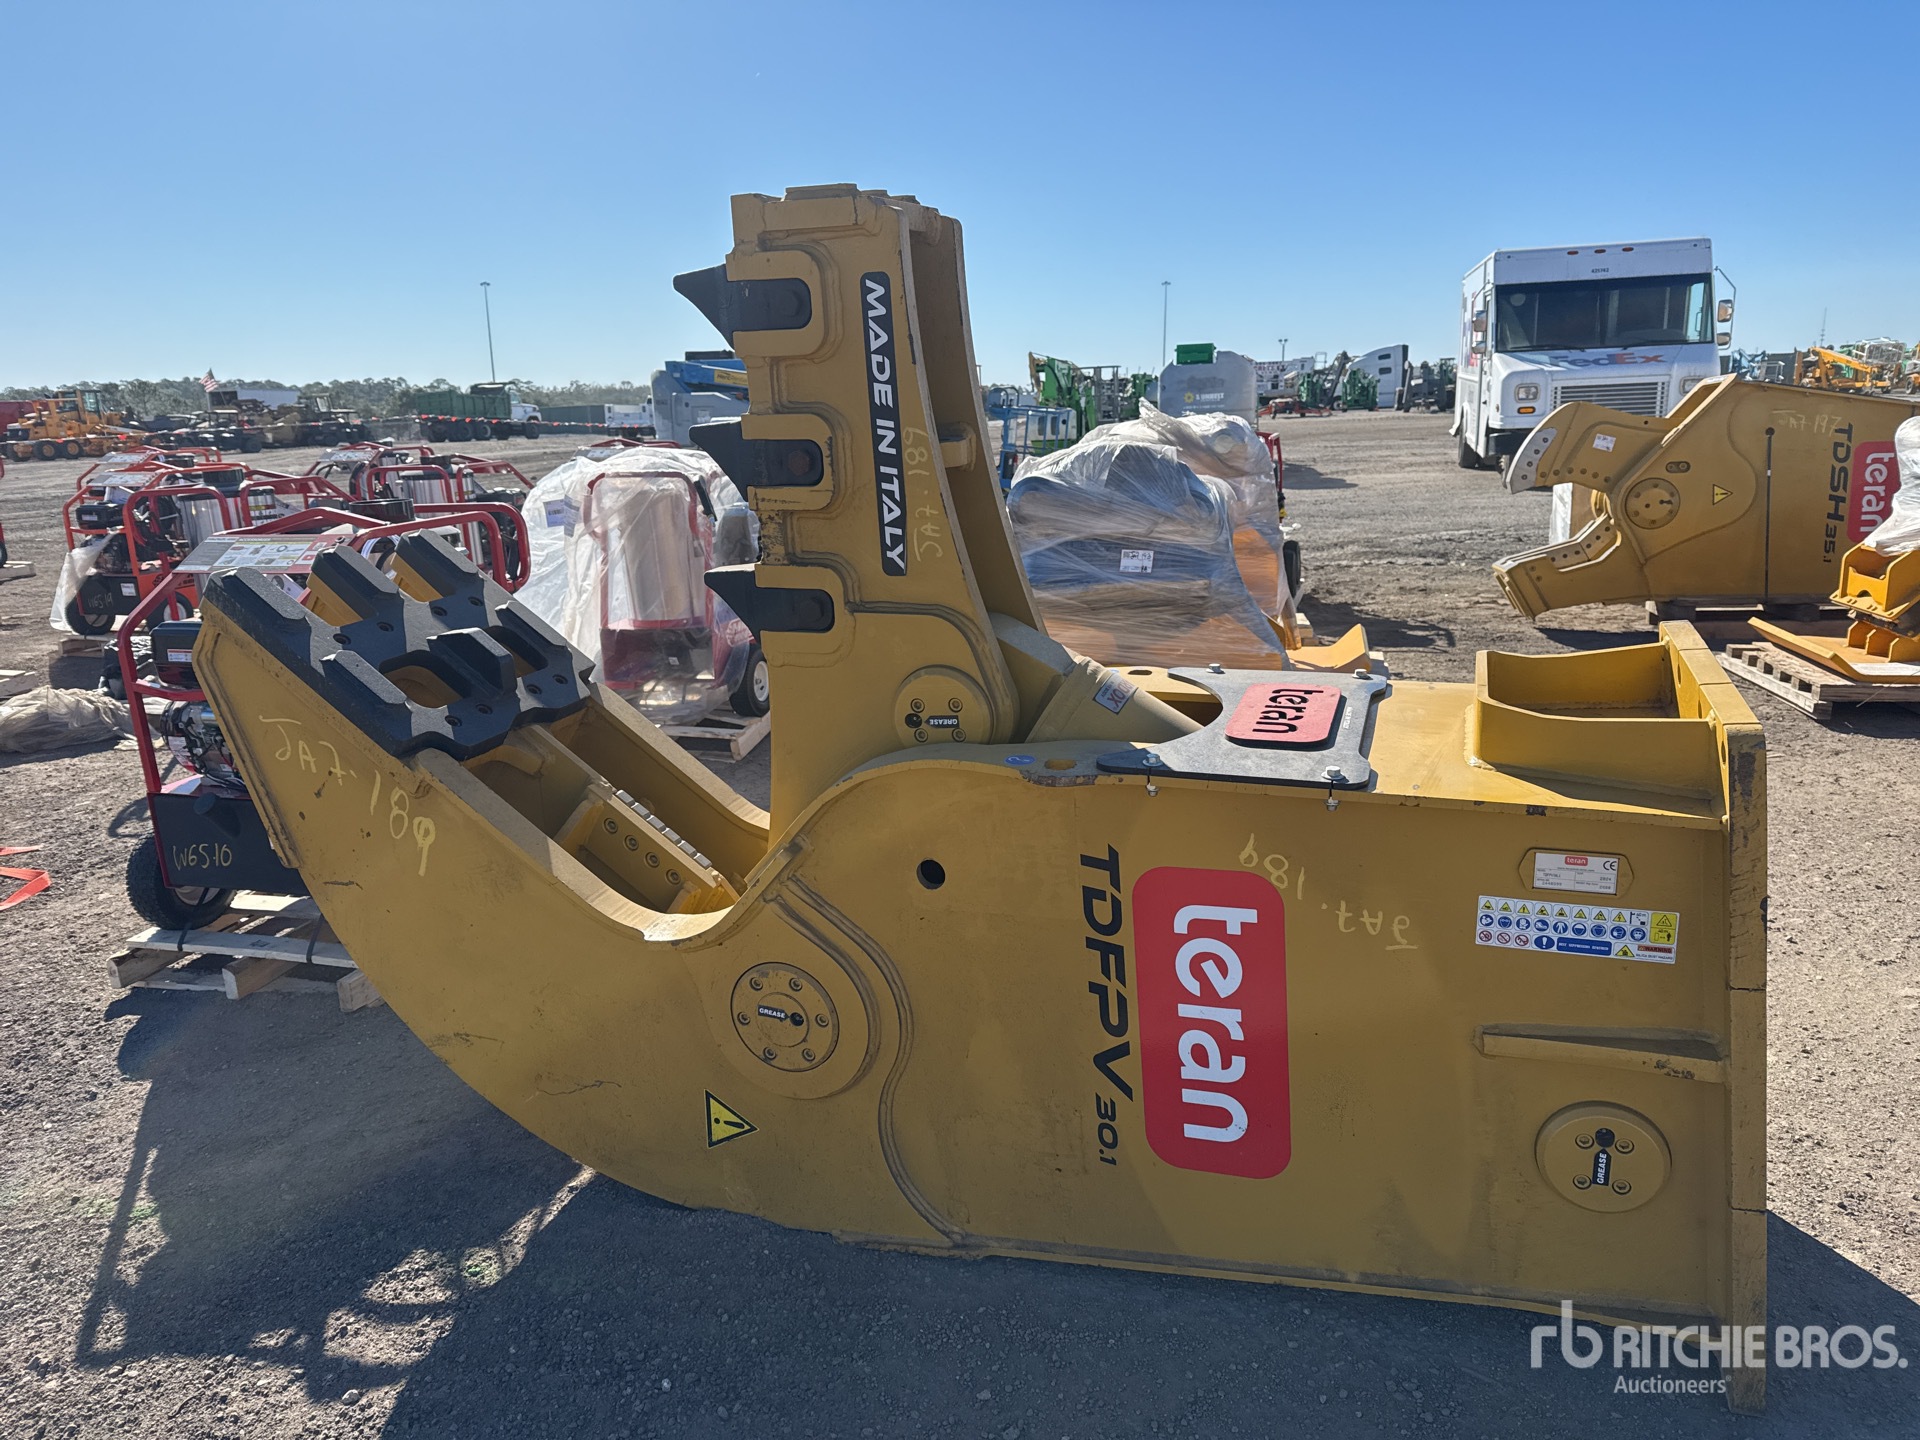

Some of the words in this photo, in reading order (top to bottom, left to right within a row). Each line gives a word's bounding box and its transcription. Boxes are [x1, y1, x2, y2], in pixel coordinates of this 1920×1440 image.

[865, 278, 894, 408] MADE
[1555, 352, 1666, 366] FedEx
[876, 418, 897, 455] IN
[1827, 422, 1854, 522] TDSH
[1859, 452, 1895, 533] teran
[879, 465, 906, 575] ITALY
[1822, 522, 1838, 563] 35.1
[929, 718, 958, 726] GREASE
[1252, 688, 1324, 734] teran
[1567, 857, 1586, 865] teran
[1645, 945, 1673, 954] WARNING
[1080, 843, 1133, 1102] TDFPV
[759, 1006, 787, 1019] GREASE
[1173, 904, 1258, 1143] teran
[1095, 1092, 1120, 1166] 30.1
[1596, 1152, 1608, 1185] GREASE
